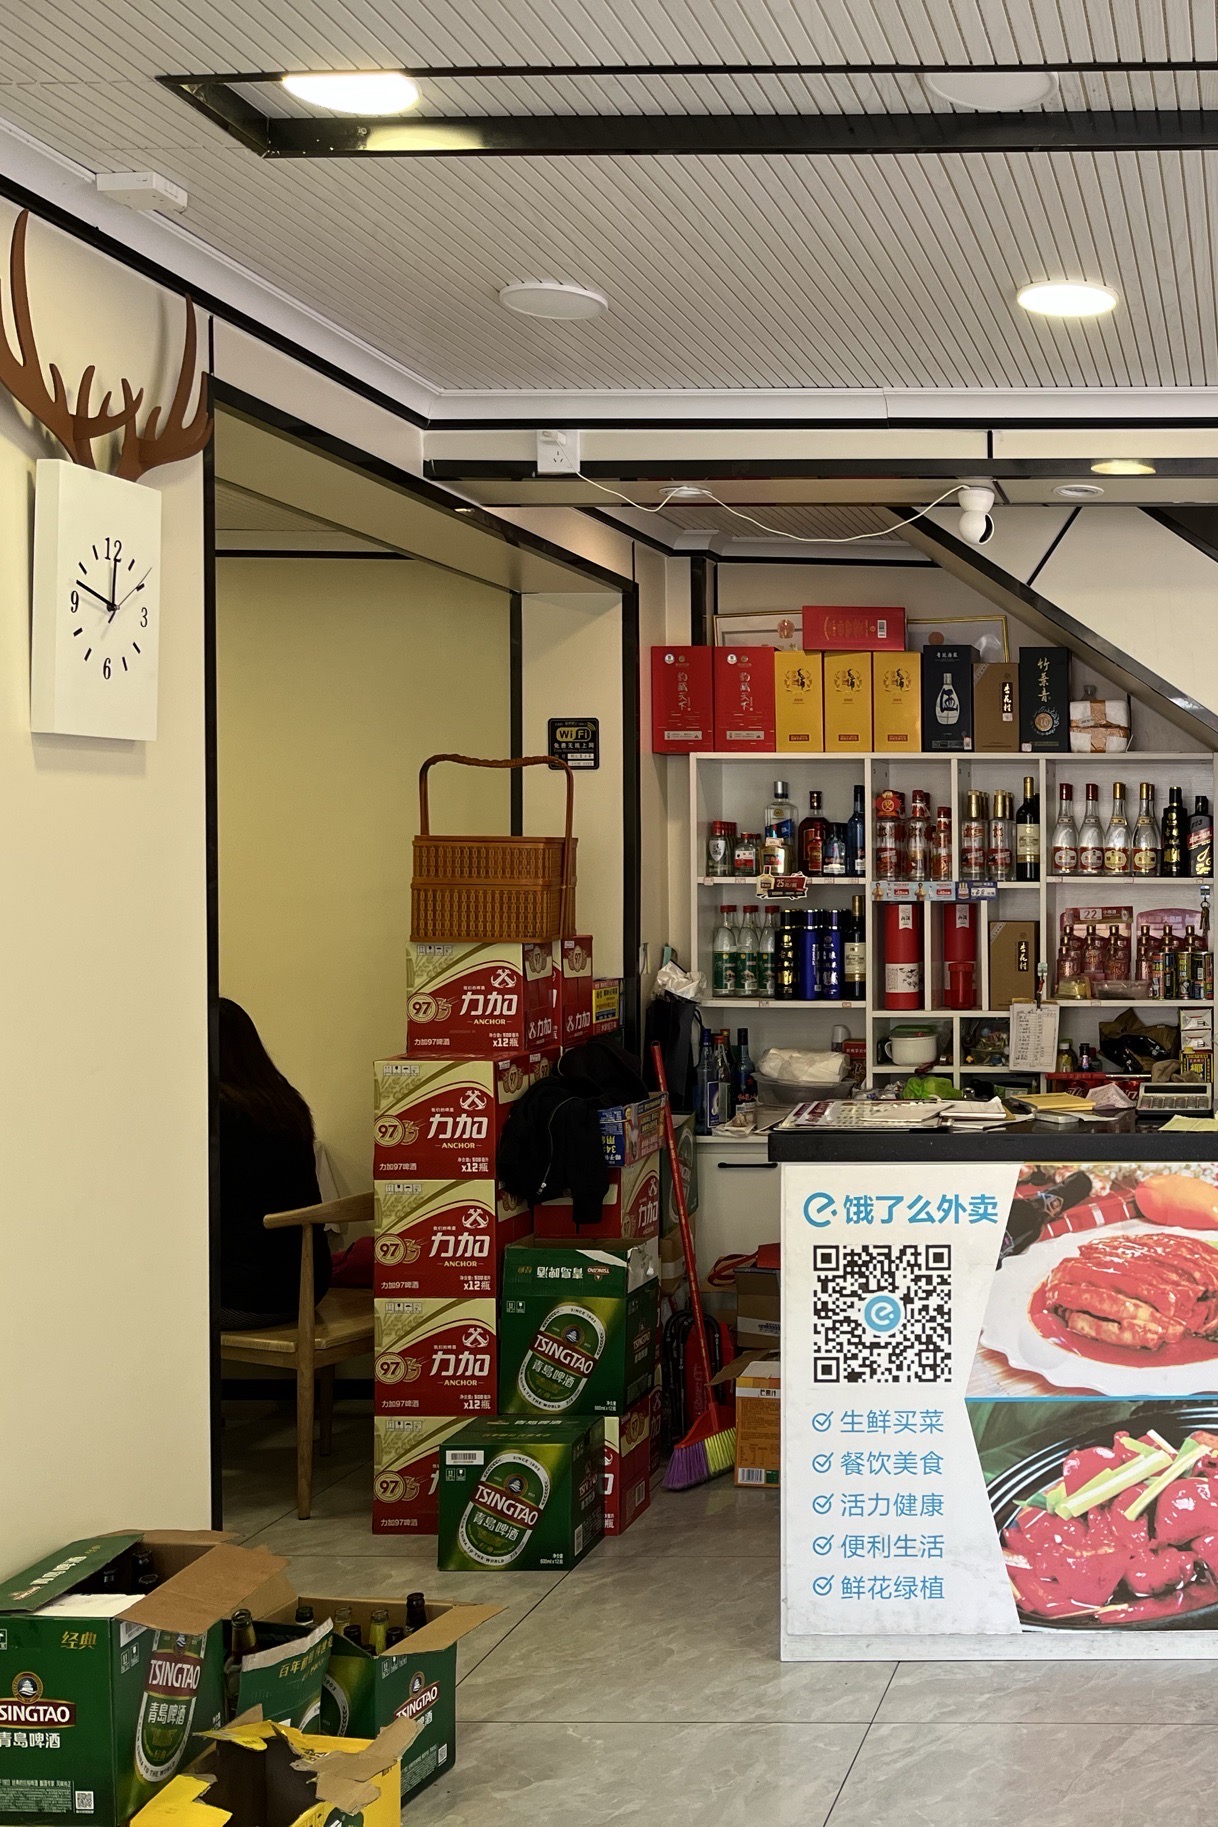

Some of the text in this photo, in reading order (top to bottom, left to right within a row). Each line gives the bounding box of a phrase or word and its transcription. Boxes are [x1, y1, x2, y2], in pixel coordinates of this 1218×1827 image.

[104, 537, 122, 563] 12
[70, 590, 79, 613] 9
[140, 607, 148, 627] 3
[103, 658, 111, 680] 6
[1084, 910, 1098, 919] 22
[412, 1002, 432, 1015] 97
[459, 991, 518, 1016] 力加
[414, 1038, 450, 1046] 力加97啤酒
[493, 1038, 519, 1047] x12瓶
[378, 1124, 398, 1138] 97
[427, 1113, 488, 1139] 力加
[379, 1163, 417, 1171] 力加97啤酒
[461, 1162, 489, 1173] x12瓶
[843, 1194, 999, 1224] 饿了么外卖
[380, 1243, 400, 1257] 97
[429, 1232, 490, 1257] 力加
[381, 1281, 419, 1290] 力加97啤酒
[463, 1281, 491, 1291] x12瓶
[429, 1351, 491, 1376] 力加
[533, 1334, 594, 1374] TSINGTAO
[380, 1362, 400, 1375] 97
[532, 1359, 576, 1389] 青岛啤酒
[381, 1400, 419, 1408] 力加97啤酒
[463, 1400, 491, 1410] x12瓶
[840, 1409, 944, 1434] 生鲜买菜
[840, 1450, 944, 1476] 餐饮美食
[379, 1480, 399, 1494] 97
[475, 1485, 538, 1526] TSINGTAO
[840, 1492, 944, 1517] 活力健康
[380, 1519, 418, 1527] 力加97啤酒
[472, 1511, 520, 1541] 青岛啤酒
[840, 1534, 944, 1559] 便利生活
[840, 1575, 945, 1600] 鲜花绿植
[61, 1631, 98, 1650] 经典
[149, 1660, 201, 1690] TSINGTAO
[148, 1702, 187, 1725] 青岛啤酒
[0, 1732, 61, 1749] 青岛啤酒
